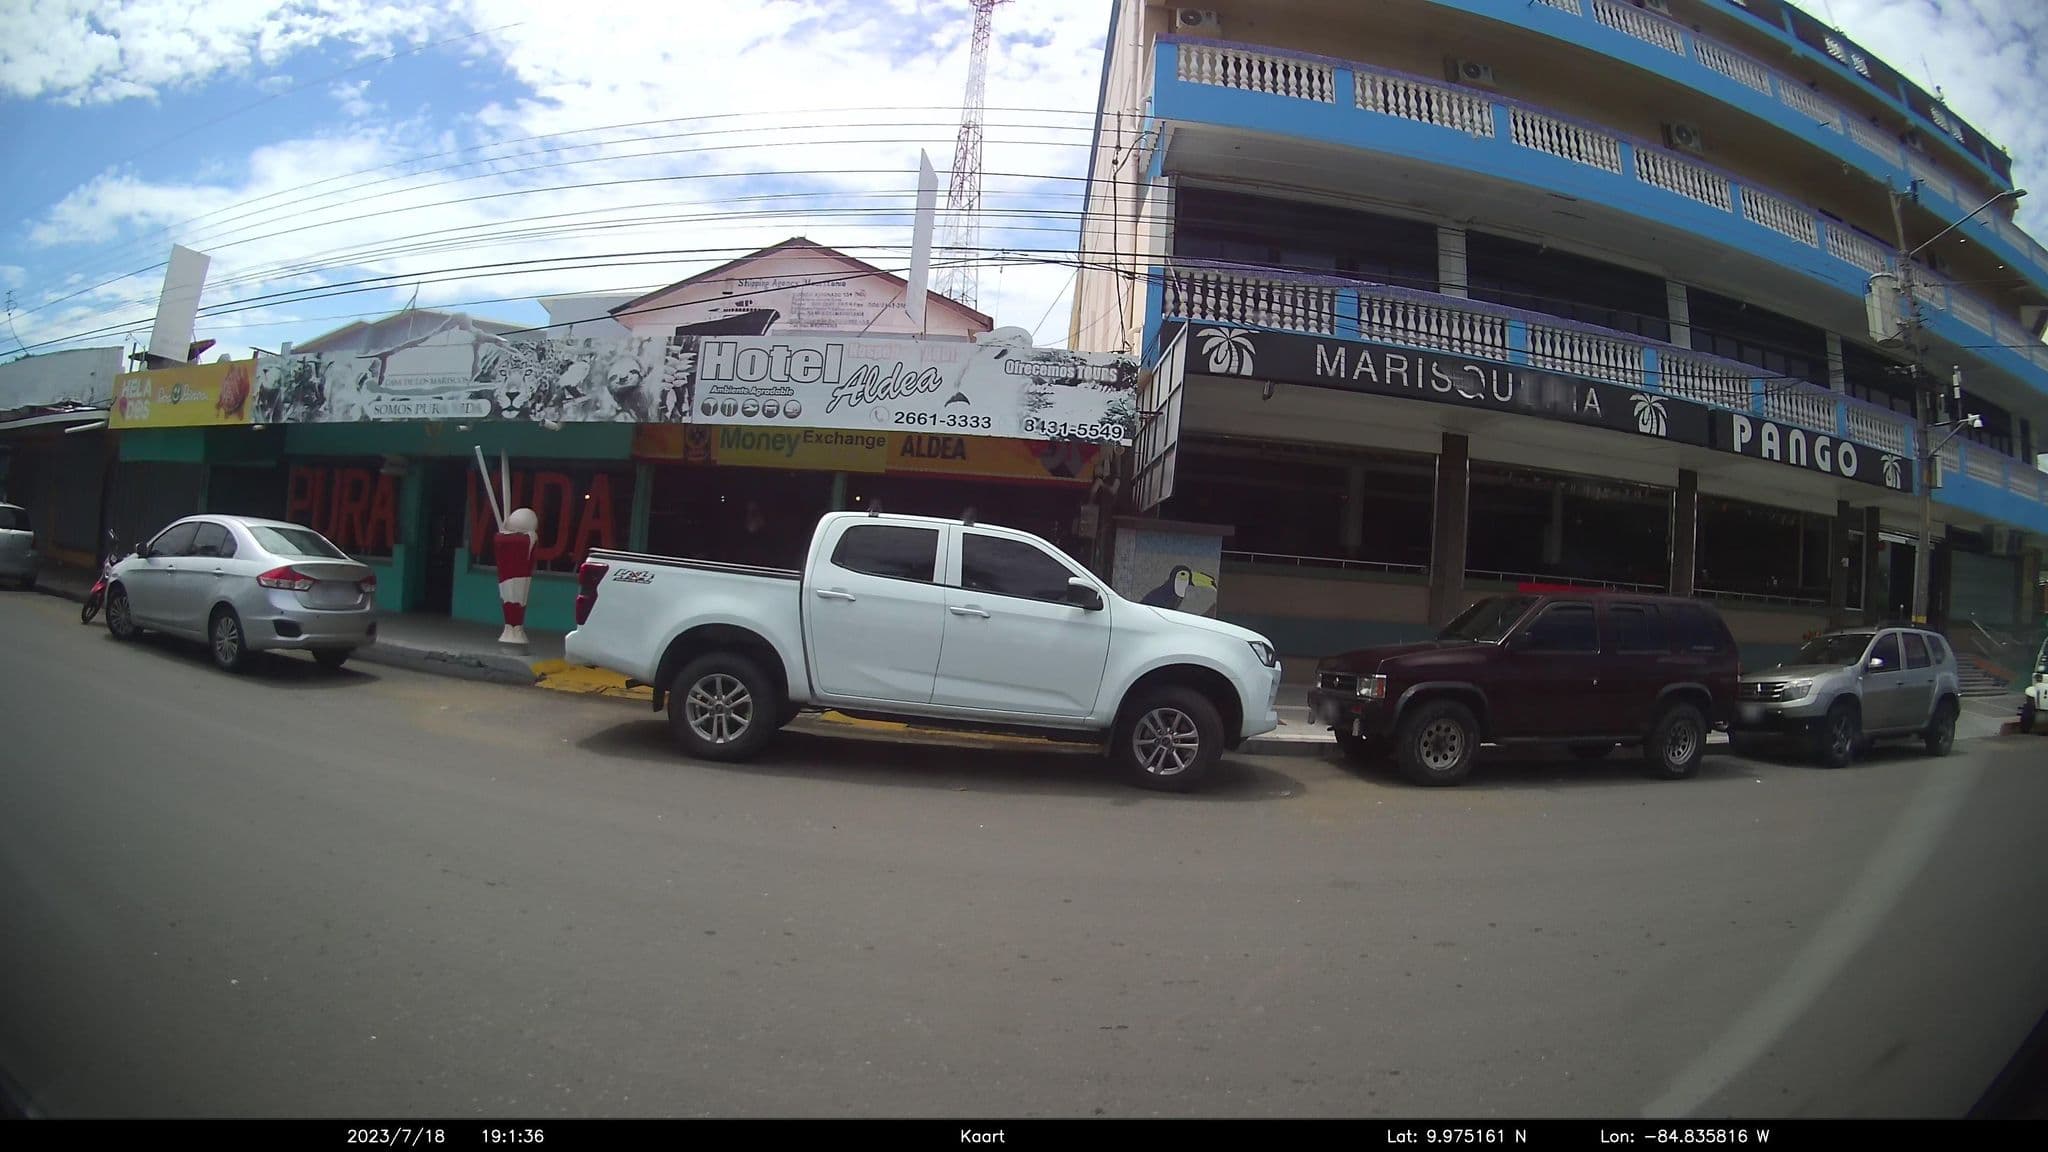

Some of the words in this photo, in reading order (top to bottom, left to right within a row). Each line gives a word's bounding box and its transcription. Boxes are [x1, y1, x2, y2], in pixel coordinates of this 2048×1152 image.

[701, 341, 844, 384] Hotel
[1004, 359, 1075, 379] Ofrecemos
[1077, 365, 1119, 383] TOURS
[121, 378, 152, 398] HELA
[709, 385, 750, 395] Ambiente
[826, 361, 943, 414] Aldea
[1315, 344, 1602, 418] MARISQUIA
[374, 403, 412, 416] SOMOS
[415, 402, 448, 415] PUR
[894, 411, 992, 429] 2661-3333
[1024, 419, 1124, 440] 8431-5549
[719, 428, 799, 458] Money
[802, 429, 886, 449] Exchange
[900, 435, 967, 460] ALDEA
[1732, 414, 1858, 478] PANGO
[287, 465, 395, 547] PURA
